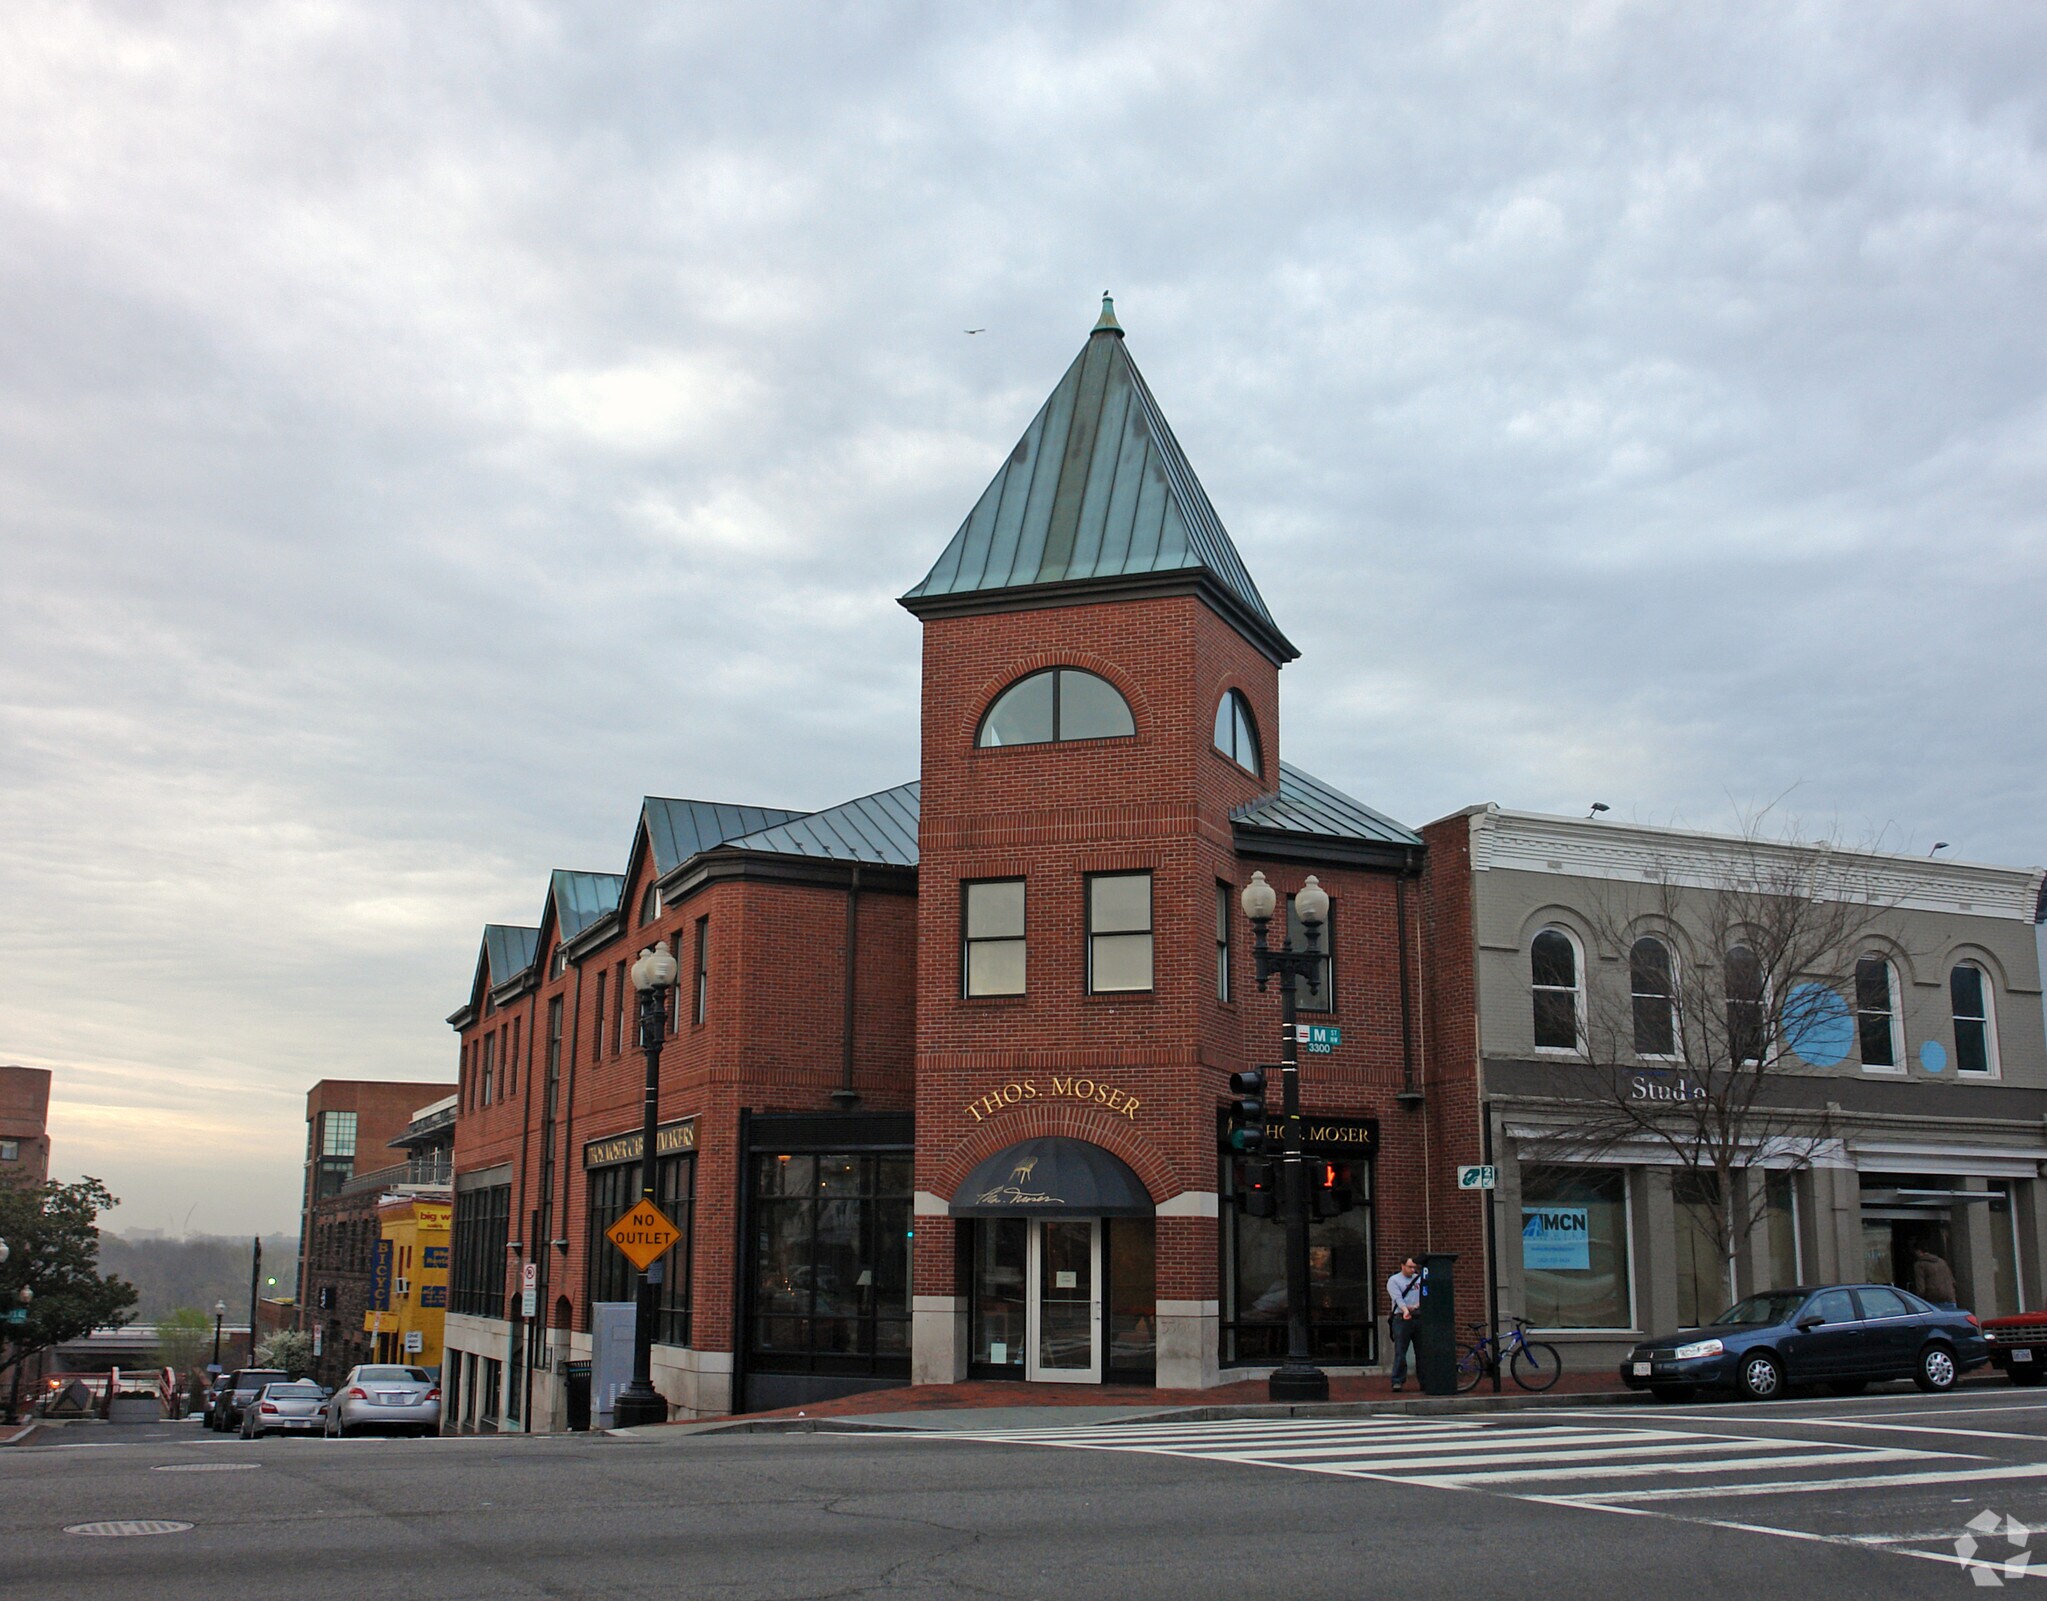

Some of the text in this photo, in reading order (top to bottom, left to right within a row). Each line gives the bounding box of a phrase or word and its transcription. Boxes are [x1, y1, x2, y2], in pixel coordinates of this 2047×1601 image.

[1313, 1028, 1326, 1042] M
[1308, 1043, 1331, 1053] 3300
[964, 1077, 1140, 1123] THOS. MOSER
[1310, 1126, 1370, 1143] MOSER
[420, 1211, 437, 1222] big
[633, 1214, 655, 1226] NO
[1544, 1214, 1586, 1231] MCN
[616, 1232, 671, 1244] OUTLET
[1423, 1267, 1429, 1279] P
